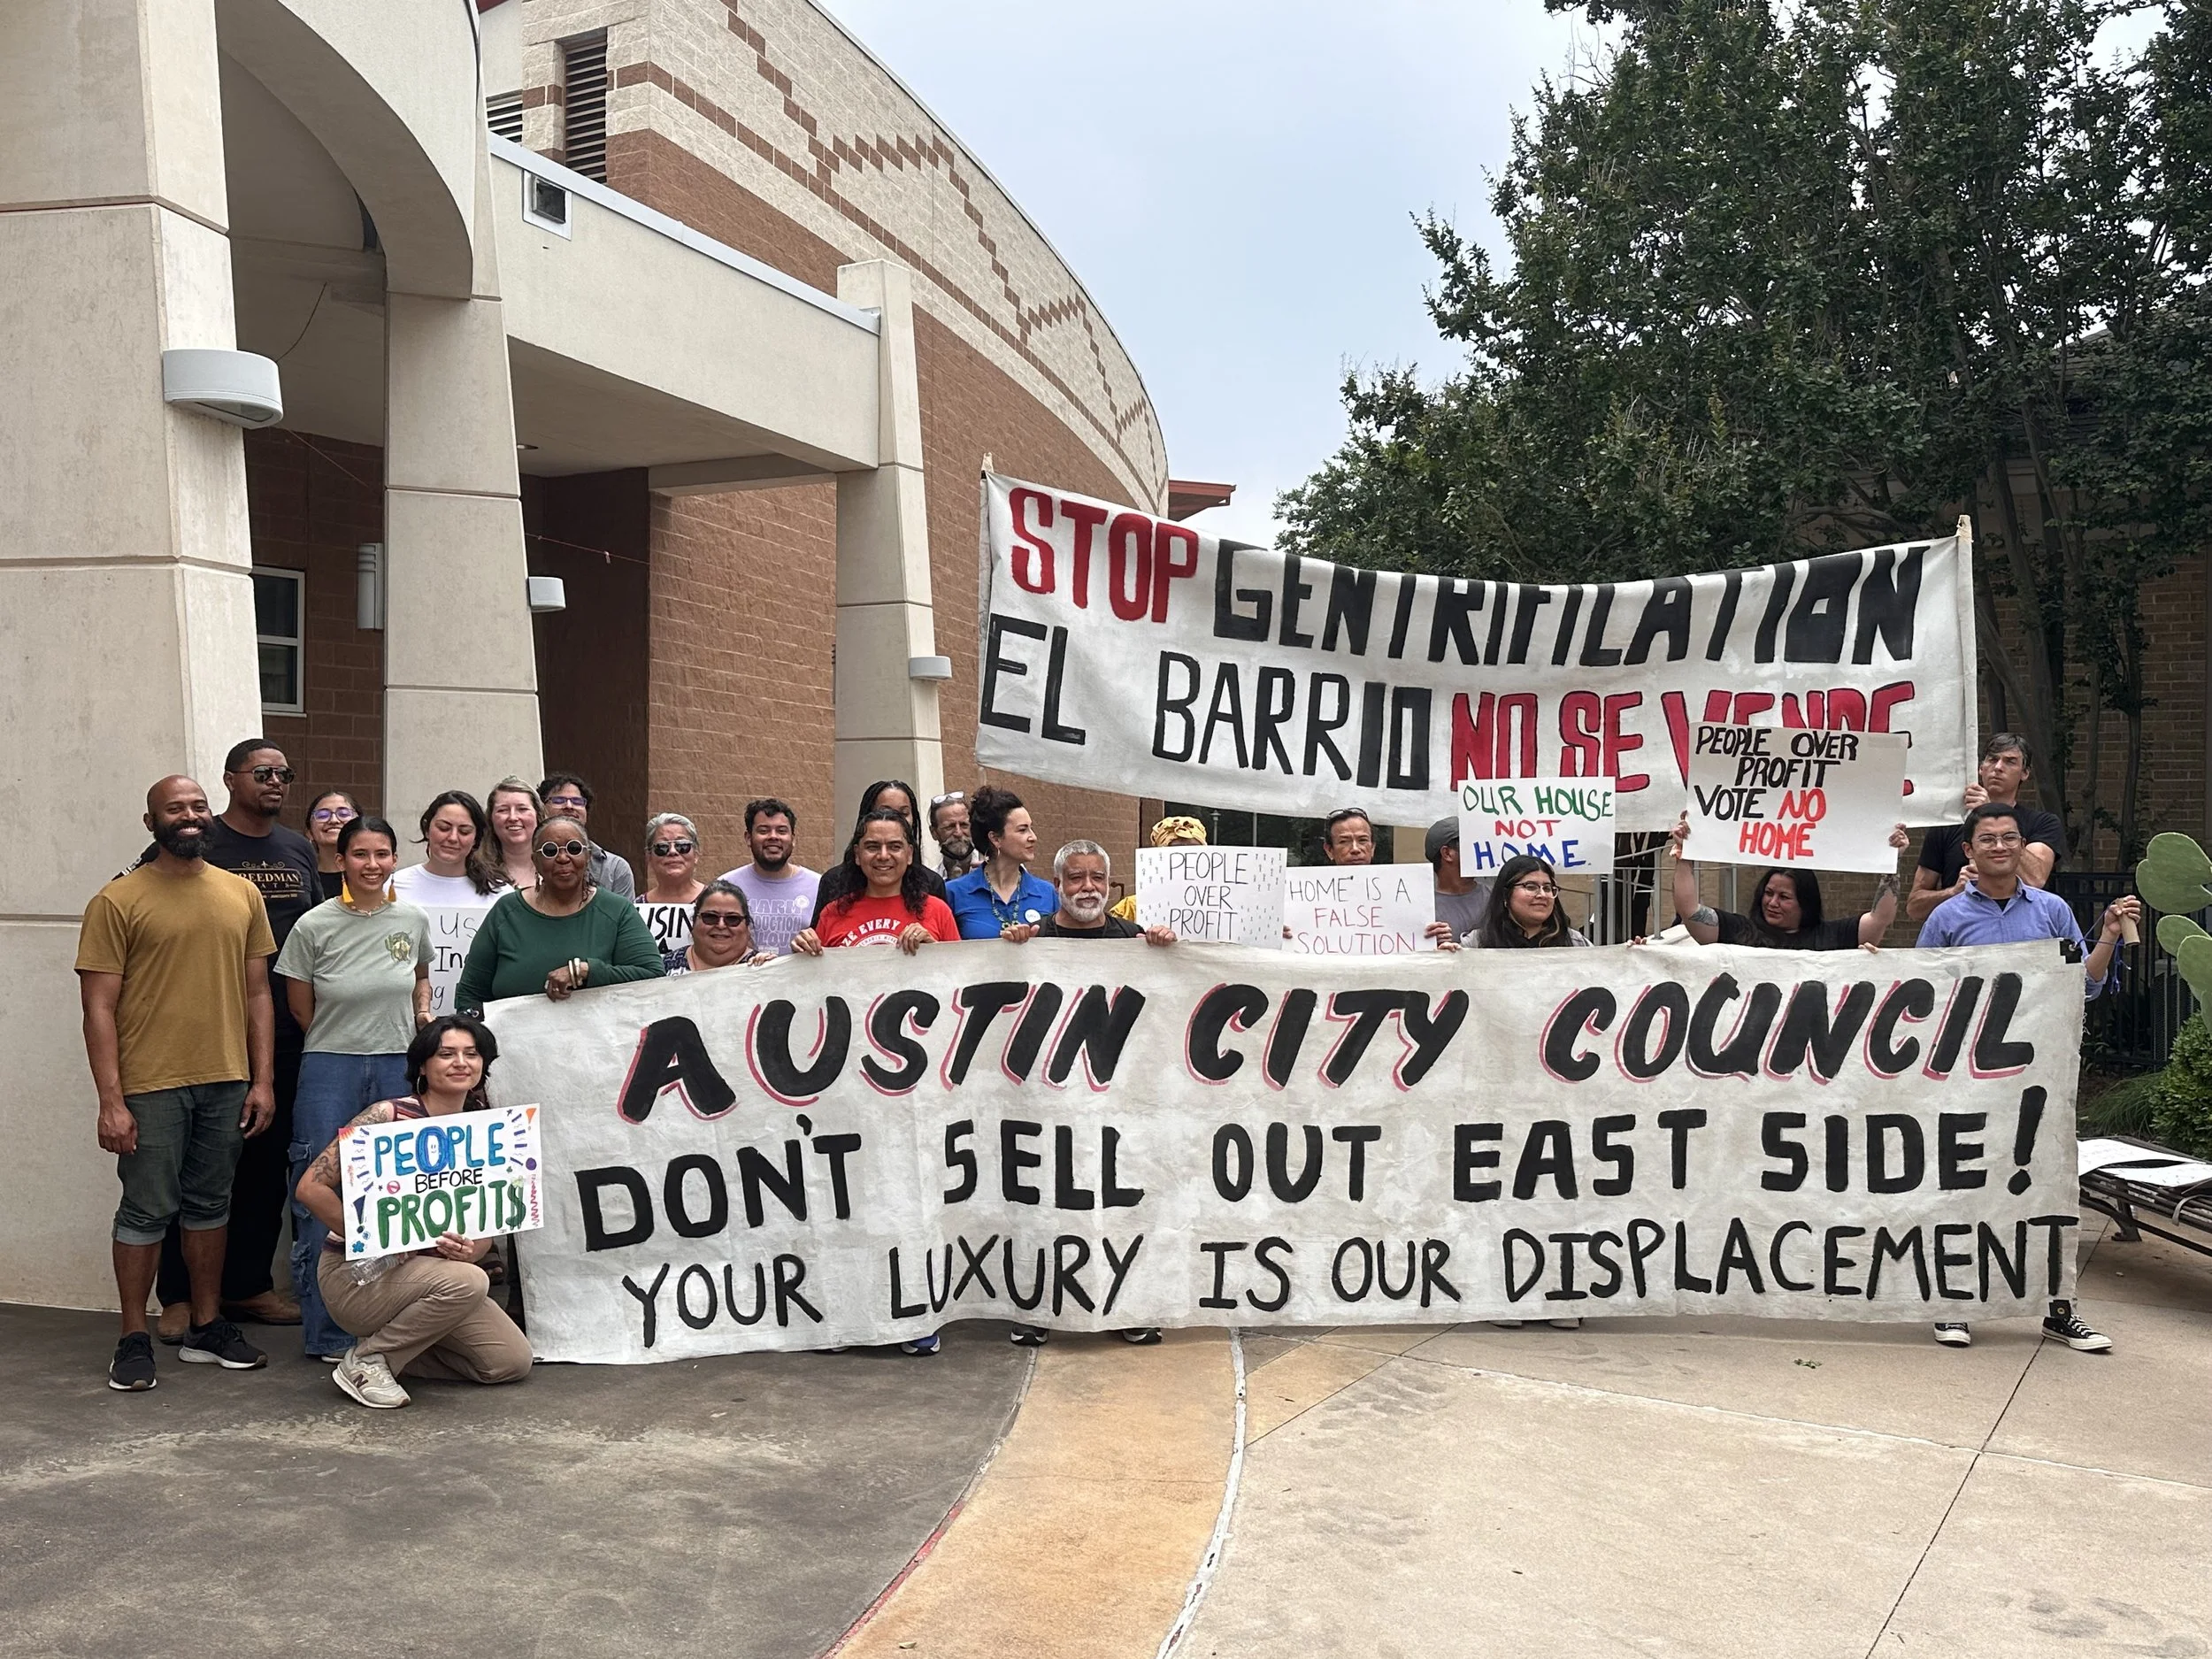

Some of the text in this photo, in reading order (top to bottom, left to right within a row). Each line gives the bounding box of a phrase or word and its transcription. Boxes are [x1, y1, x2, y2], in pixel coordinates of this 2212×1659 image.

[1009, 488, 1199, 622] STOP
[979, 612, 1086, 745] EL
[1152, 650, 1432, 790] BARRIO
[1449, 692, 1538, 792] NO
[1559, 691, 1650, 793] SE
[1695, 726, 1859, 760] PEOPLE OVER
[1734, 757, 1840, 787] PROFIT
[1463, 784, 1613, 821] OUR HOUSE
[1694, 785, 1827, 822] VOTE NO
[1494, 819, 1562, 839] NOT
[1739, 821, 1816, 860] HOME
[1170, 852, 1248, 885] PEOPLE
[1184, 885, 1233, 910] OVER
[1366, 877, 1382, 901] IS
[1395, 878, 1411, 903] A
[858, 918, 901, 934] EVERY
[1170, 908, 1238, 940] PROFIT
[1314, 905, 1385, 928] FALSE
[1294, 932, 1416, 956] SOLUTION
[618, 972, 2034, 1125] AUSTIN CITY COUNCIL
[374, 1122, 506, 1178] PEOPLE
[415, 1168, 483, 1194] BEFORE
[575, 1114, 862, 1252] DON'T
[944, 1118, 1145, 1210] SELL
[1211, 1121, 1381, 1203] OUT
[1454, 1109, 1707, 1202] EAST
[621, 1214, 2079, 1348] YOUR LUXURY IS OUR DISPLACEMENT
